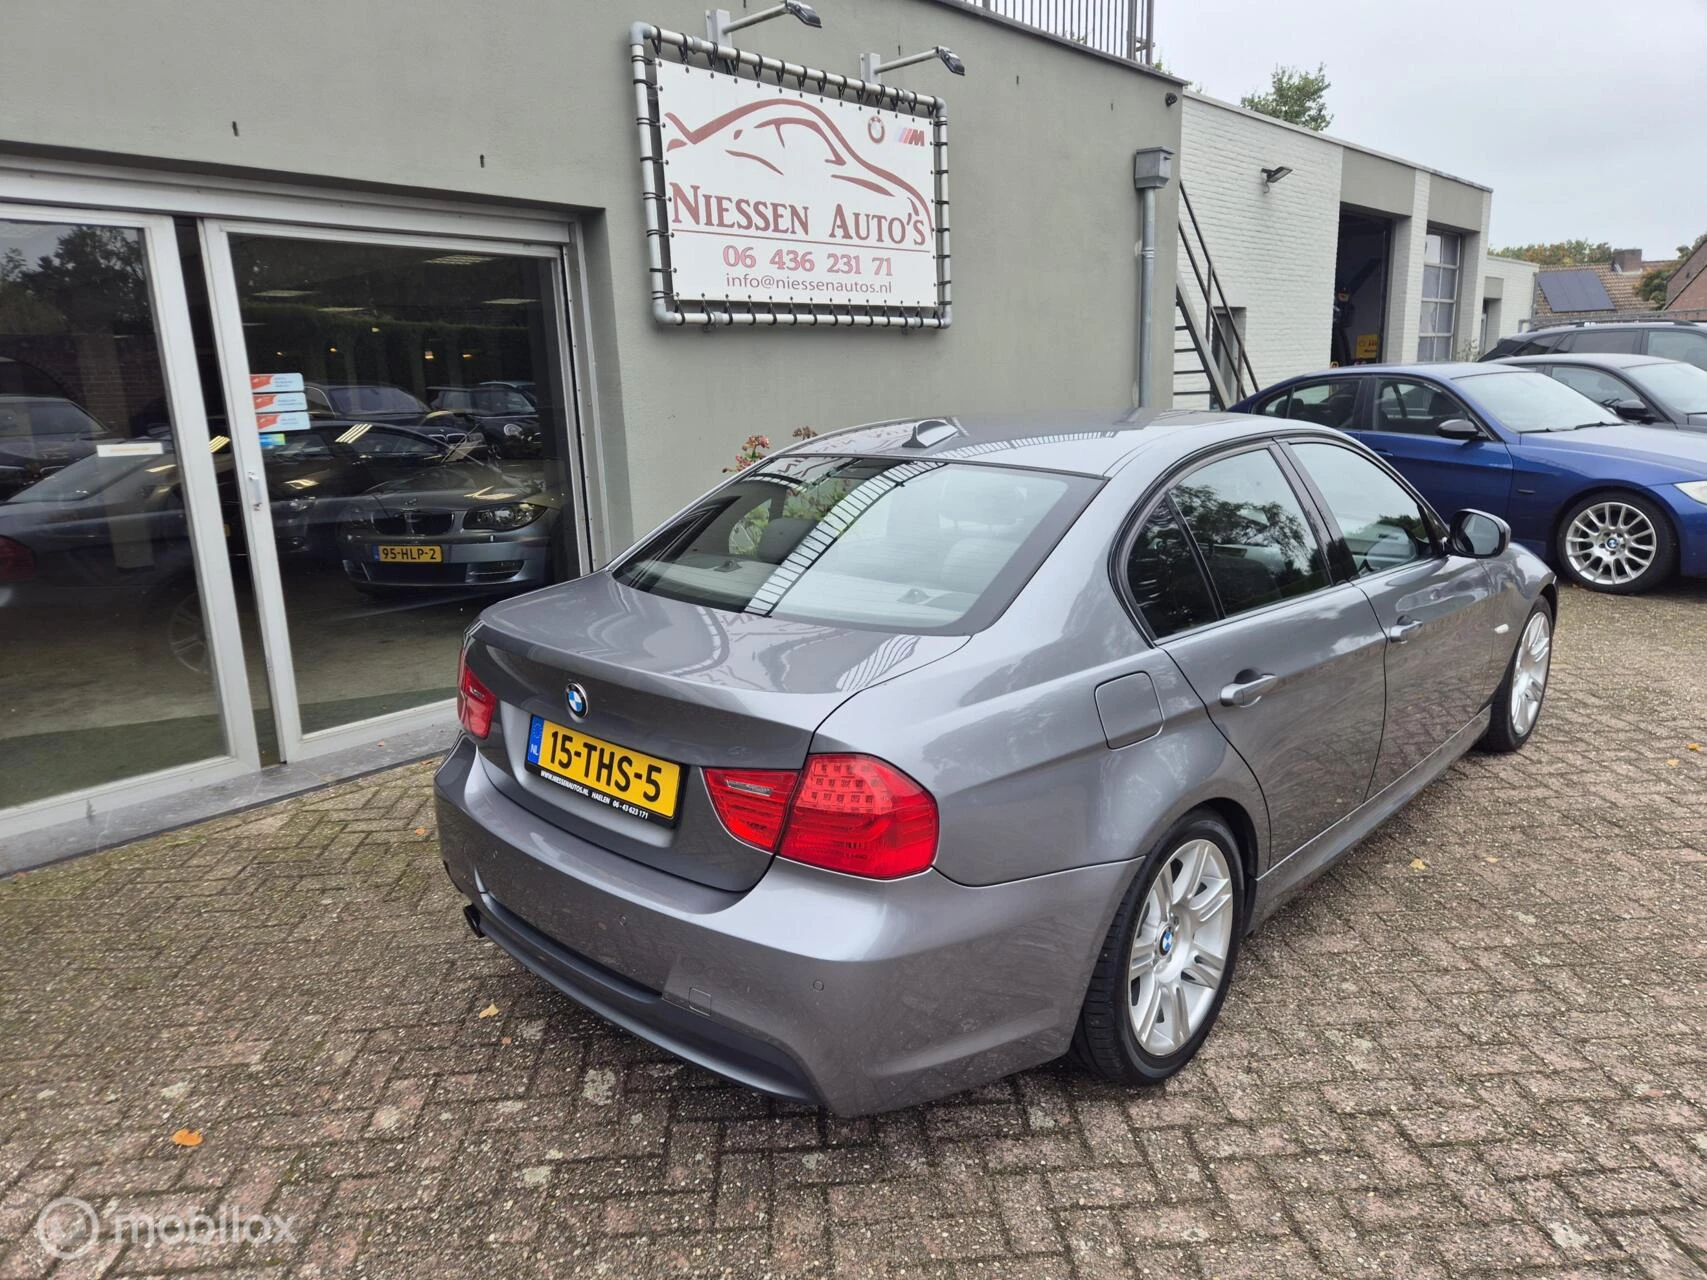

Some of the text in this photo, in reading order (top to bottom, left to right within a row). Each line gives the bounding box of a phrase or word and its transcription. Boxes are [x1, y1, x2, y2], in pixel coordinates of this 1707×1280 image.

[722, 244, 893, 276] 06 436 231 71
[725, 272, 892, 294] info@niessenautos.nl
[382, 548, 436, 560] 95-HLP-2
[530, 743, 539, 756] NL
[550, 730, 662, 803] 15-THS-5
[628, 806, 639, 816] 623
[639, 810, 649, 820] 171
